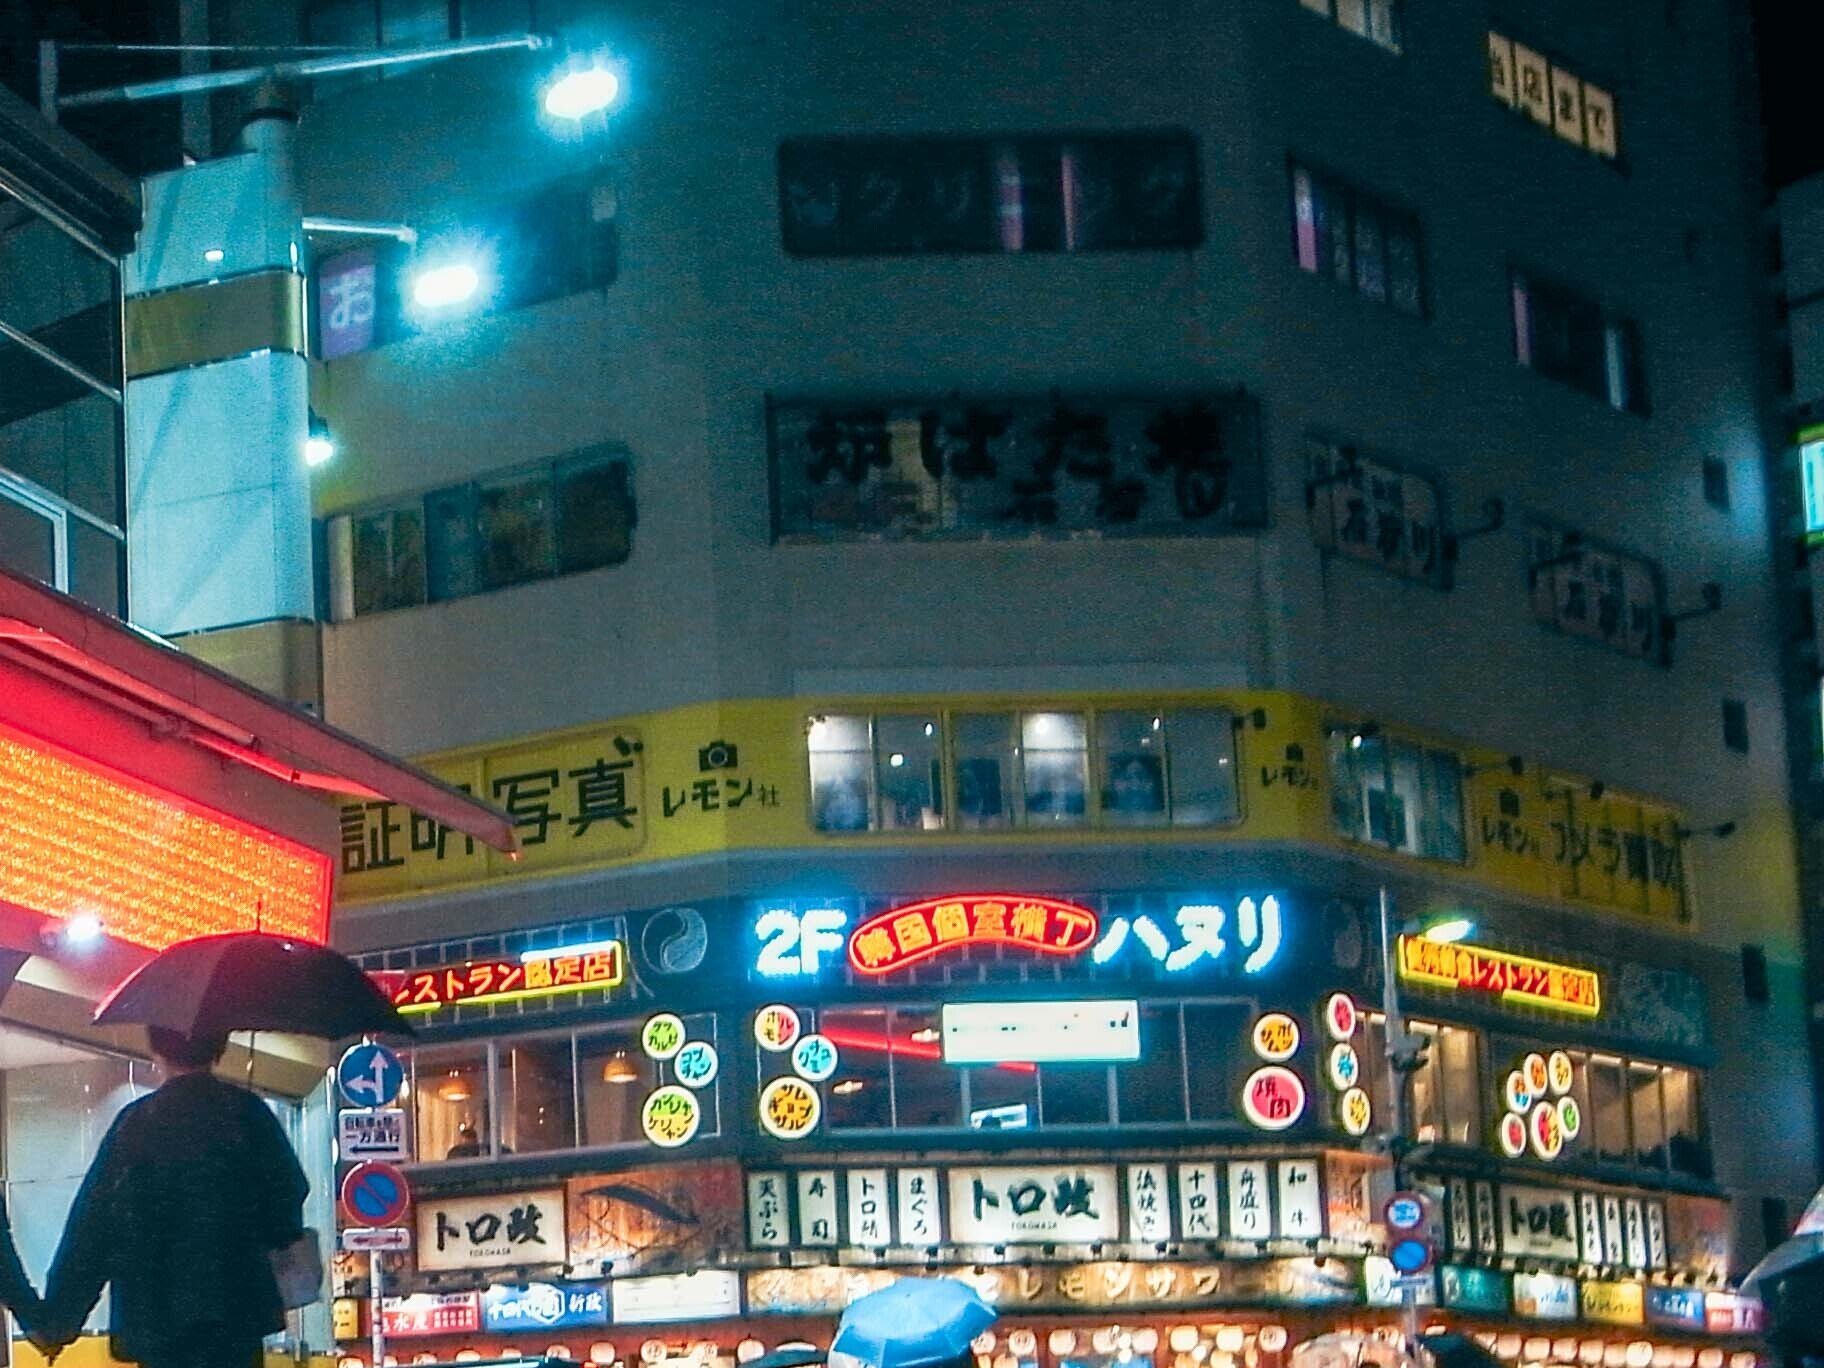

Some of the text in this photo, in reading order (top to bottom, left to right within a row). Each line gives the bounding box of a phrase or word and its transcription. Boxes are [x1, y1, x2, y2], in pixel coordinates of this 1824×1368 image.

[755, 908, 847, 977] 2F
[1093, 895, 1281, 974] ハヌリ
[759, 1178, 778, 1240] 天ぷら
[1188, 1169, 1210, 1233] 十四代
